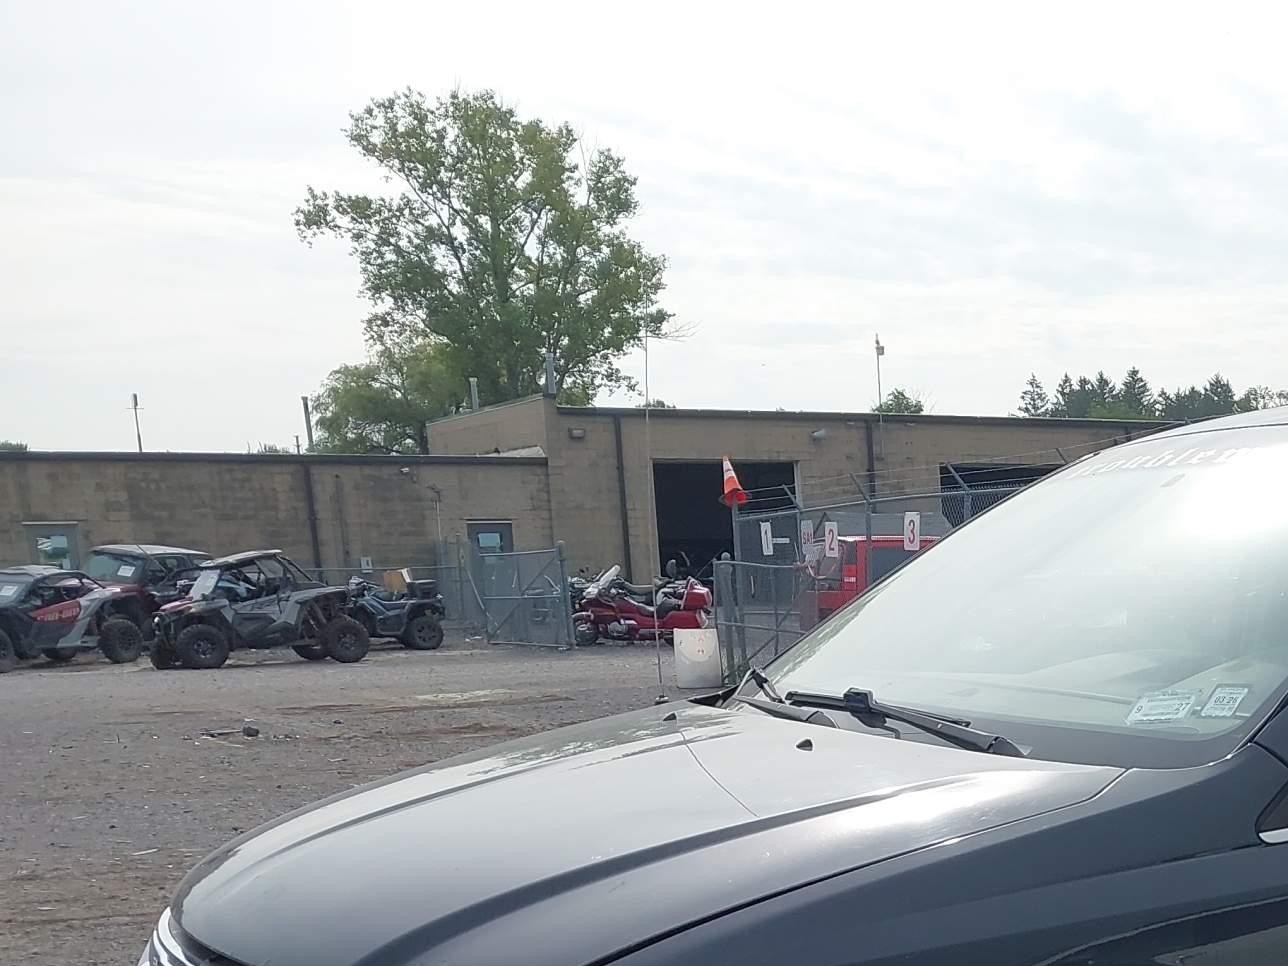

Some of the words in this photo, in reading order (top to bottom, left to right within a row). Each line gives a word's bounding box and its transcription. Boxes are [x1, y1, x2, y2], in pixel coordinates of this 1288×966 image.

[763, 527, 771, 550] 1
[827, 528, 836, 551] 2
[908, 519, 916, 545] 3
